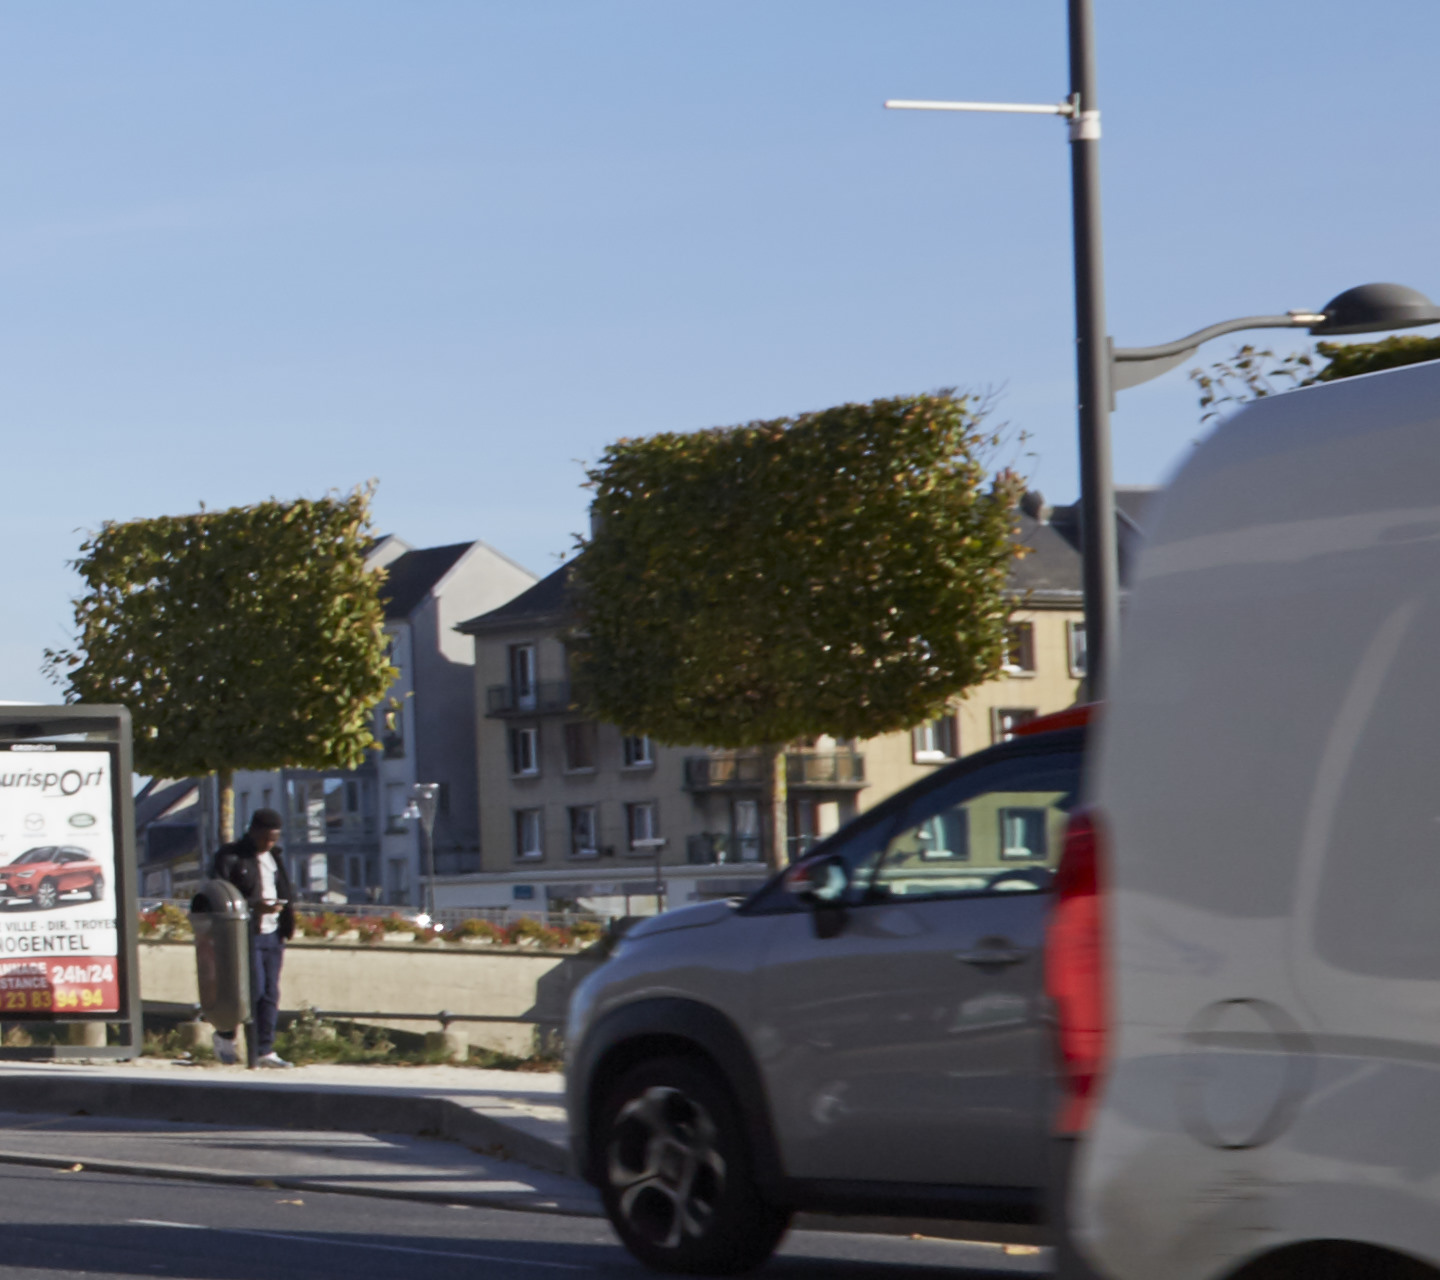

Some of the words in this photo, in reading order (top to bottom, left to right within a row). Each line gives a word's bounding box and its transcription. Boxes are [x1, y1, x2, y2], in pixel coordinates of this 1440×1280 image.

[6, 920, 36, 932] VILLE
[51, 964, 114, 984] 24h/24
[6, 991, 27, 1009] 23
[32, 990, 52, 1009] 83
[56, 990, 78, 1008] 94
[82, 988, 104, 1007] 94
